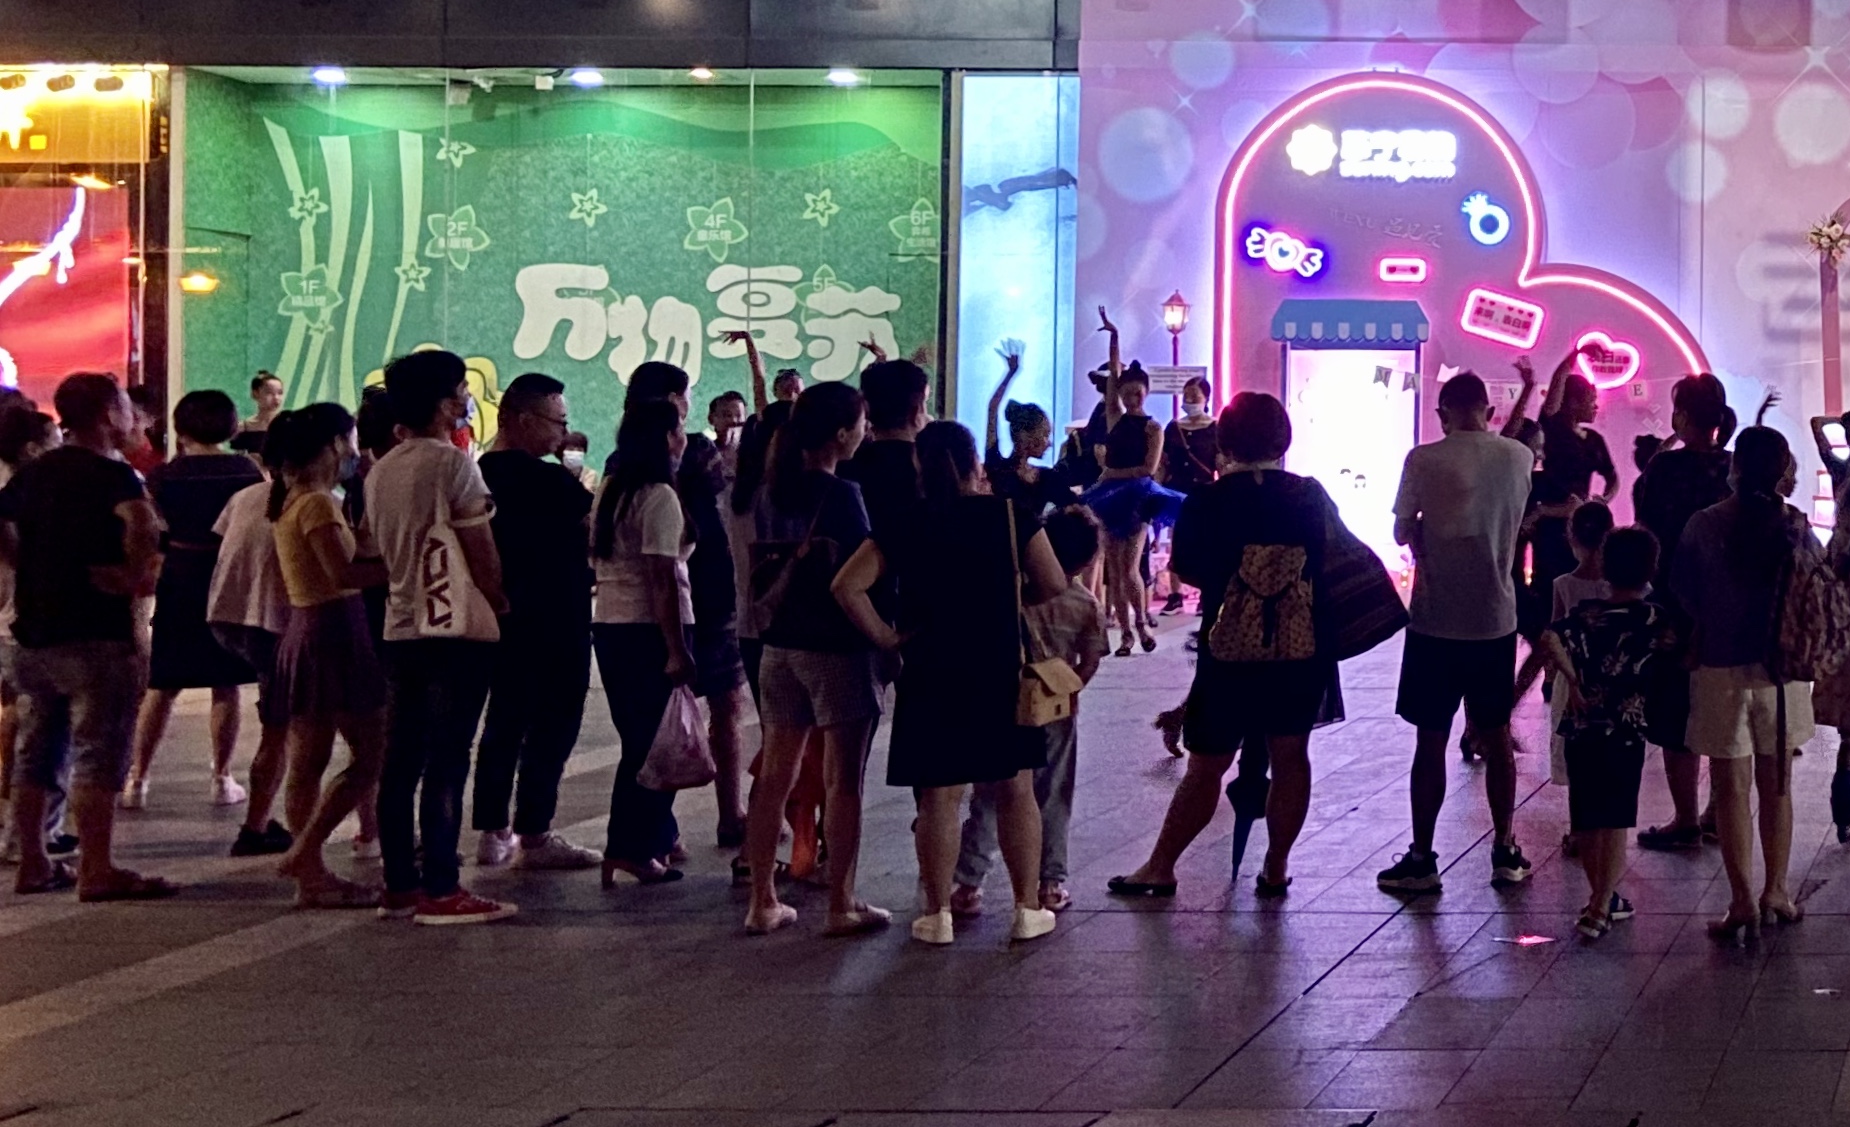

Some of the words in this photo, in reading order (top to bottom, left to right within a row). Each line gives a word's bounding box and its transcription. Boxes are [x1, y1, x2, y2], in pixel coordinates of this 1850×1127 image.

[704, 213, 727, 228] 4F
[911, 210, 933, 226] 6F
[446, 221, 468, 235] 2F
[299, 278, 320, 295] 1F
[1508, 387, 1519, 400] Y
[1633, 383, 1643, 397] E
